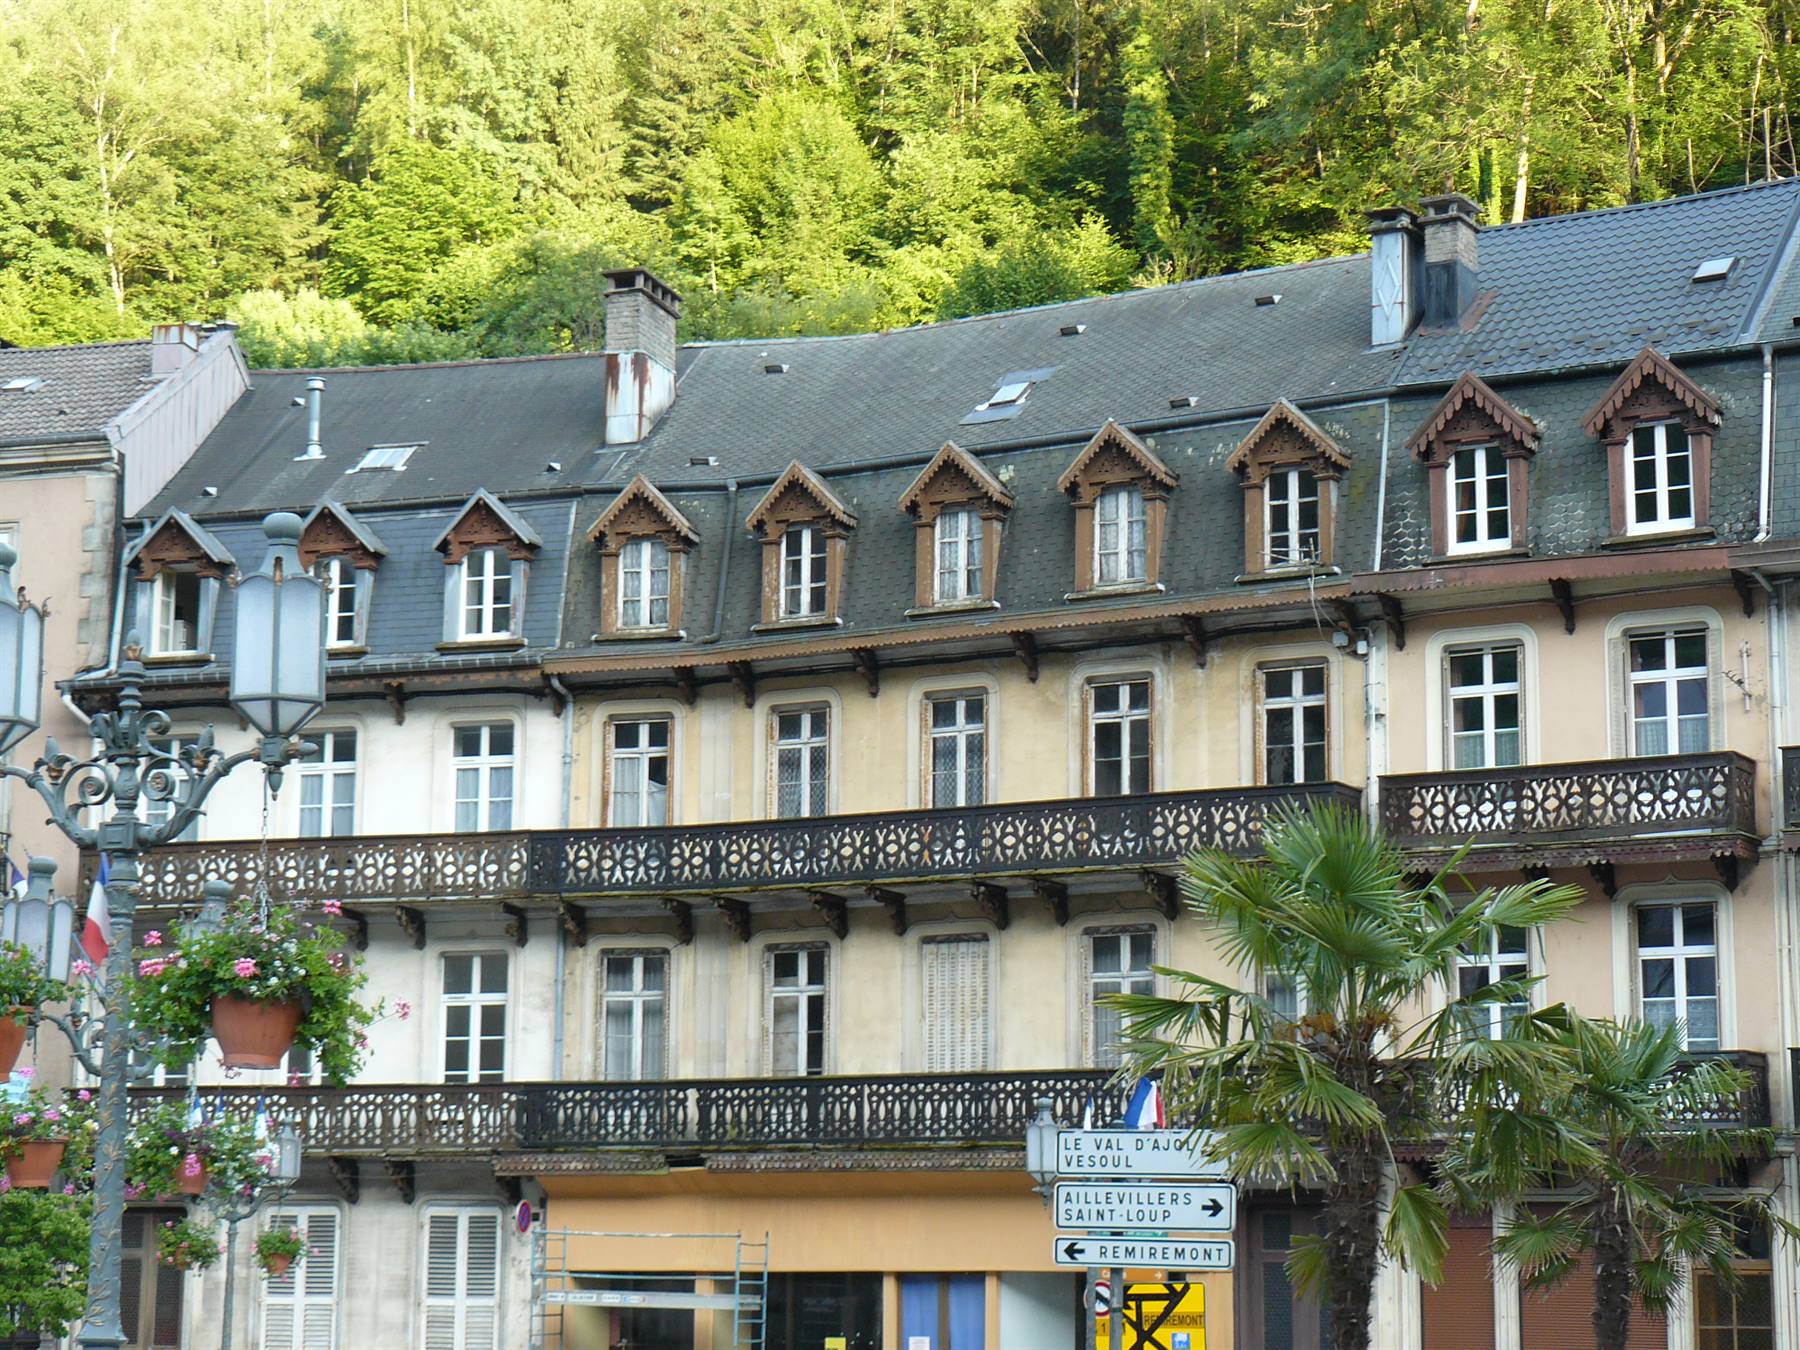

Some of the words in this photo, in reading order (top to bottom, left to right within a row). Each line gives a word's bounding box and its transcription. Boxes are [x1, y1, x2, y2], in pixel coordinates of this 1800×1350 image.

[1064, 1138, 1082, 1151] LE
[1094, 1138, 1124, 1151] VAL
[1065, 1154, 1133, 1168] VESOUL
[1064, 1191, 1193, 1206] AILLEVILLERS
[1064, 1208, 1172, 1223] SAINT-LOUP
[1100, 1245, 1224, 1262] REMIREMONT
